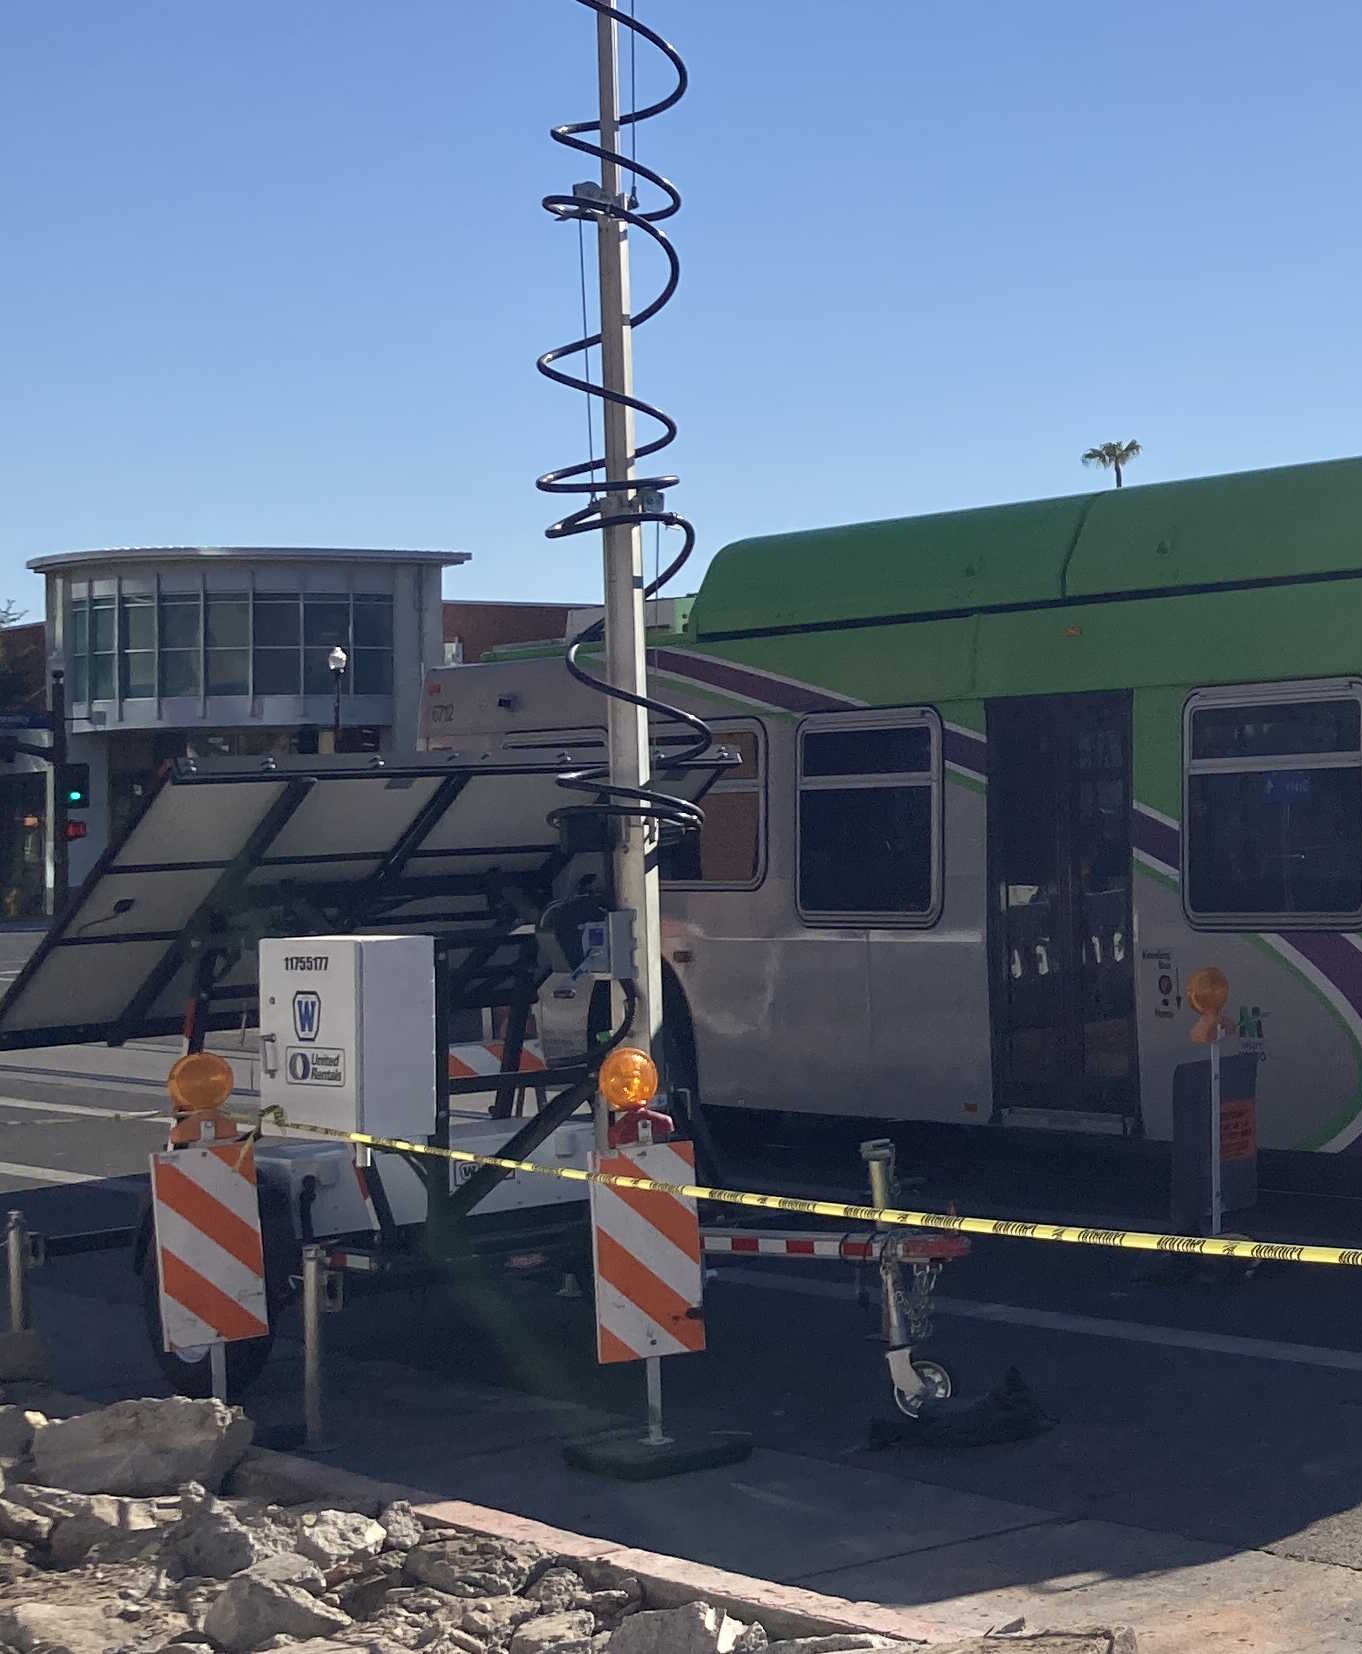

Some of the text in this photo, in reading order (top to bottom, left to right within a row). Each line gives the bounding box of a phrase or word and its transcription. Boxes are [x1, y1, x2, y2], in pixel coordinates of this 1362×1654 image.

[284, 956, 329, 971] 11755177
[297, 1000, 317, 1033] W
[311, 1053, 340, 1067] United
[311, 1068, 342, 1082] Rentals
